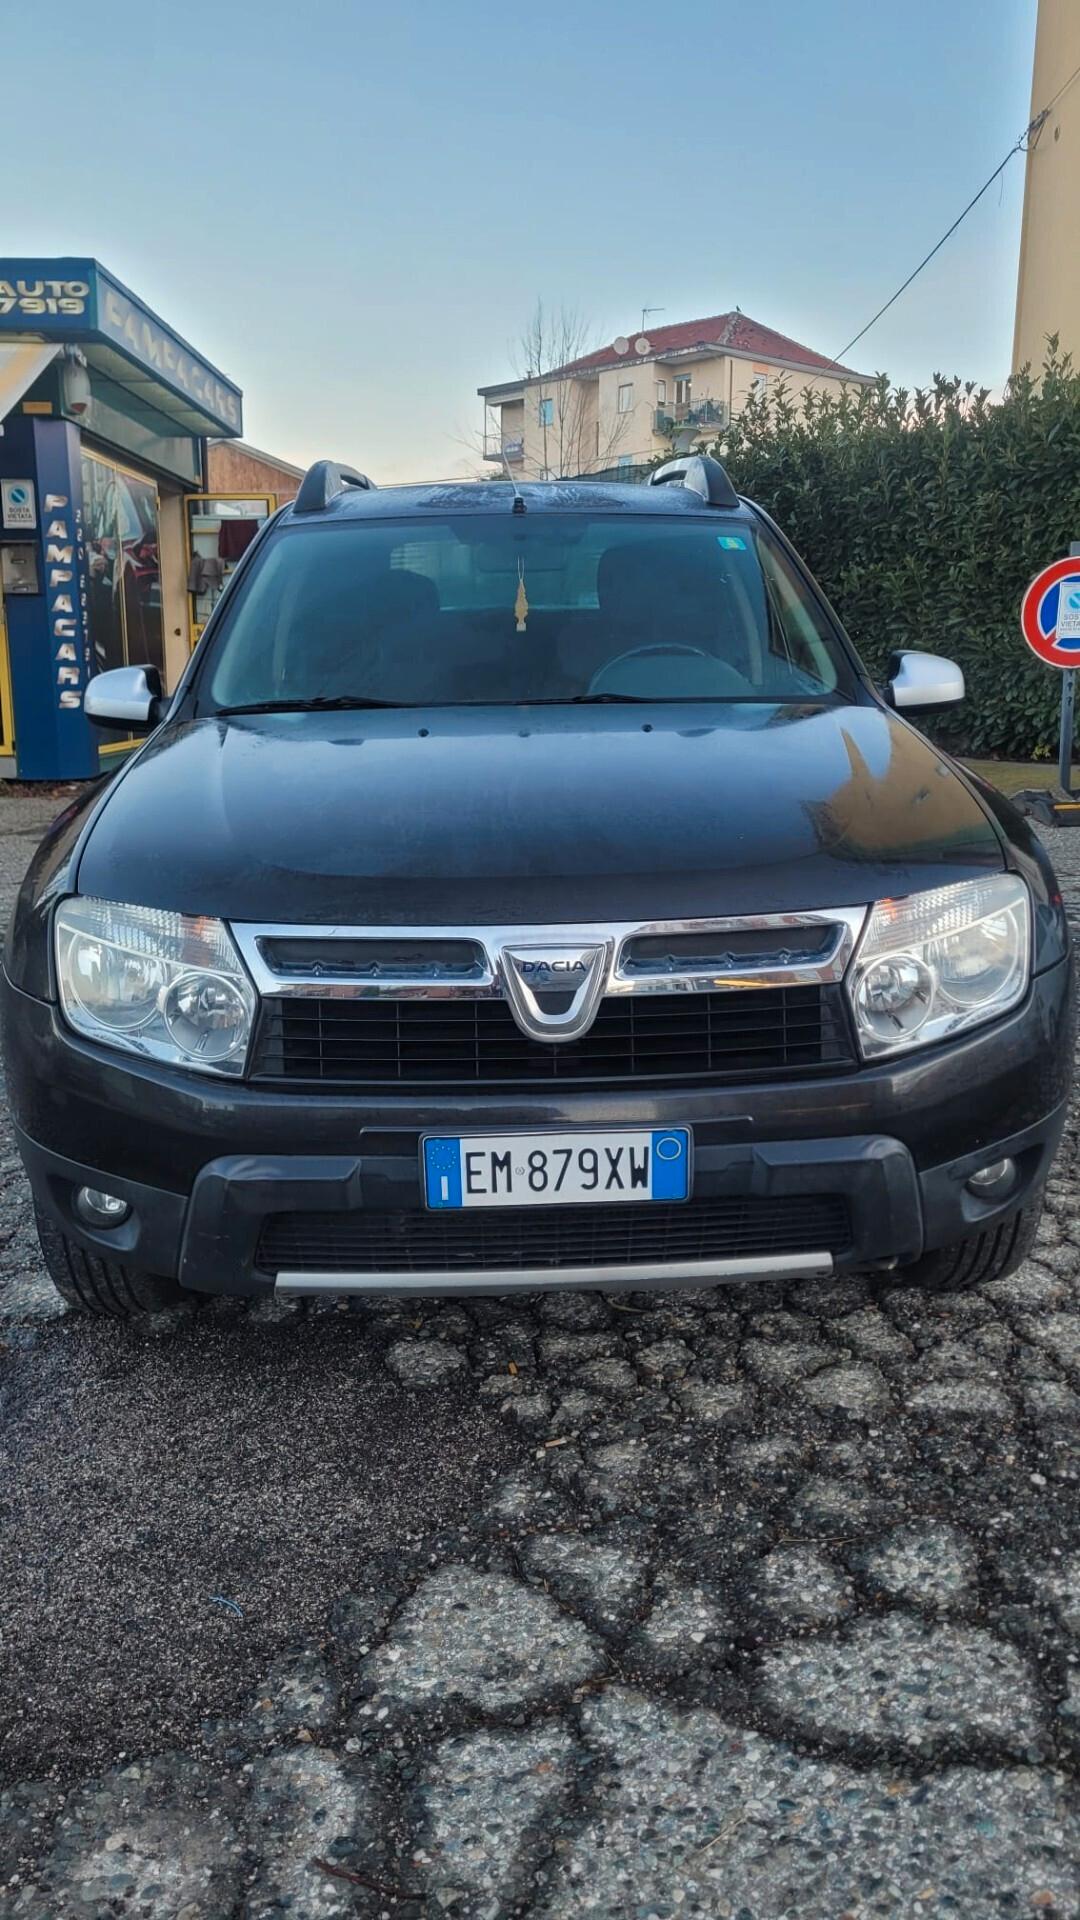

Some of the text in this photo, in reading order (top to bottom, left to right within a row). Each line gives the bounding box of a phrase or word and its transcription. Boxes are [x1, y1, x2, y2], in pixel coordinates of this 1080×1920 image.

[0, 280, 89, 297] AUTO
[0, 297, 85, 315] 7919
[44, 493, 82, 709] PAMPACARS
[522, 961, 586, 973] DACIA
[465, 1146, 650, 1194] EM 879XW
